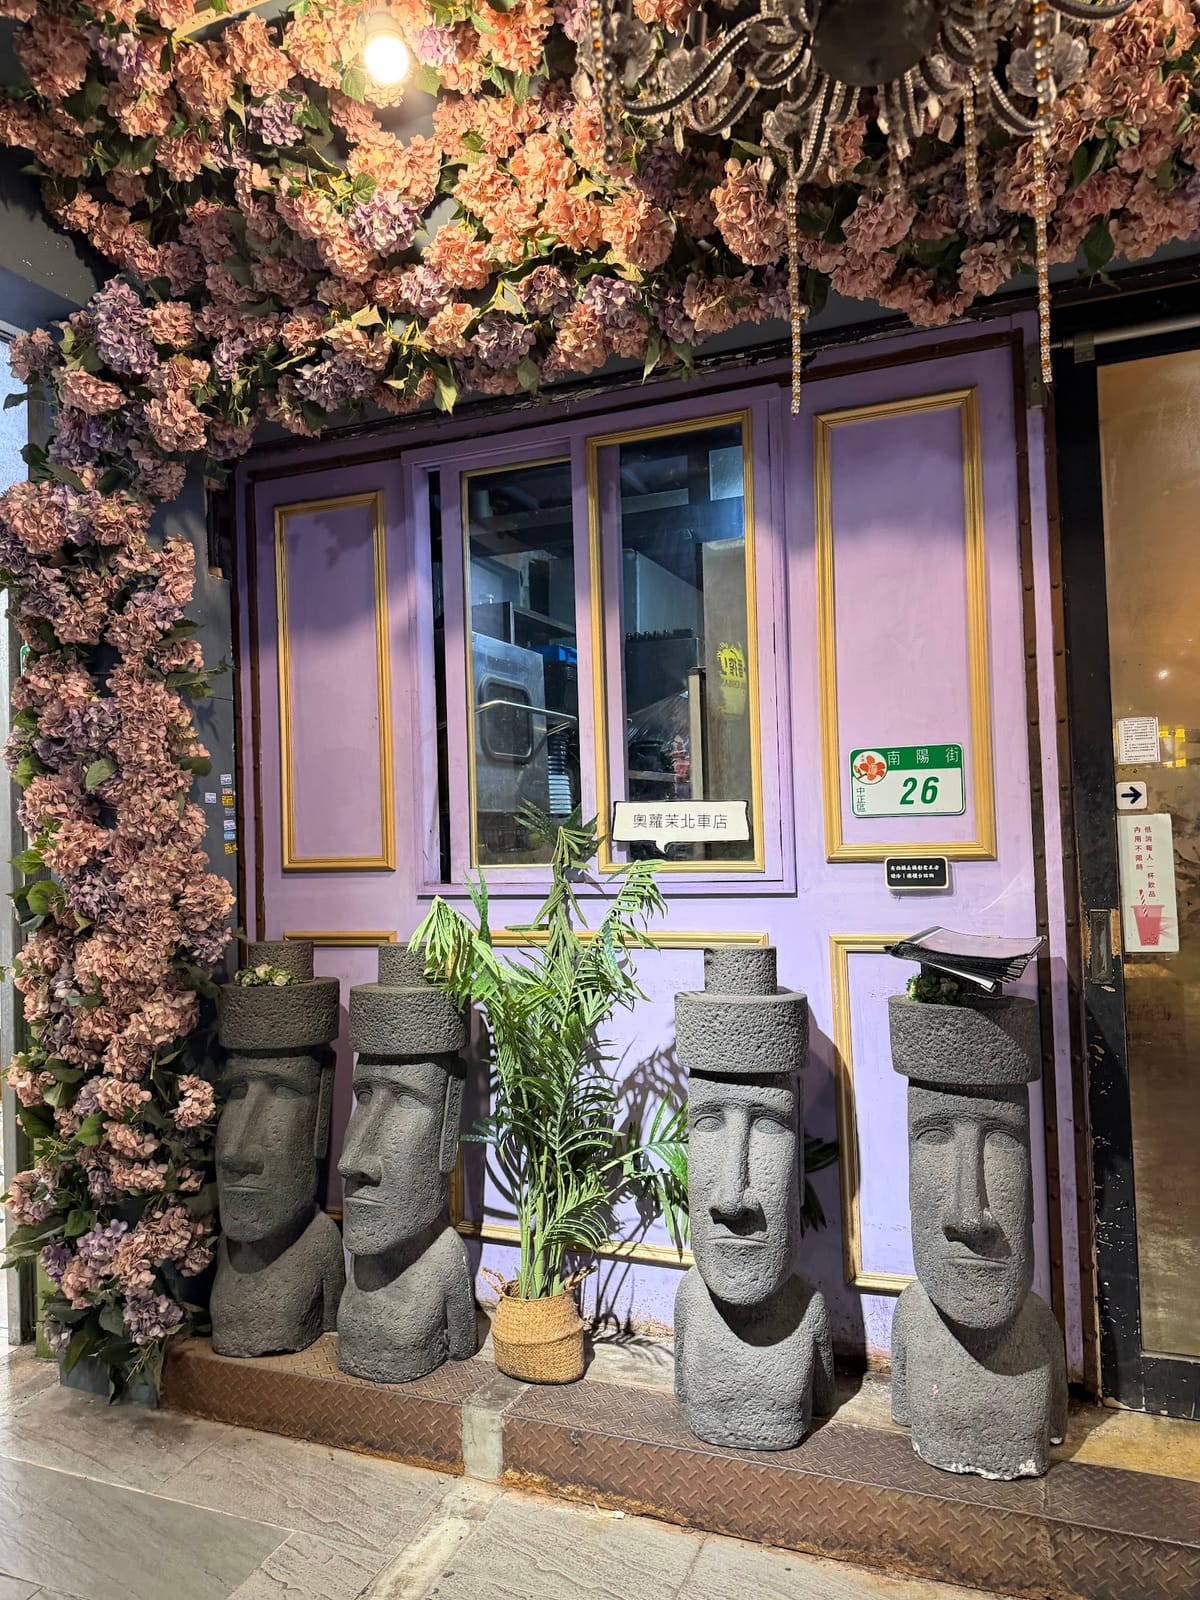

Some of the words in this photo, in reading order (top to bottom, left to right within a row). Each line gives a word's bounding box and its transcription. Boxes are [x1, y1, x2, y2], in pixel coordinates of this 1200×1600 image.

[887, 747, 959, 766] 南陽街
[856, 786, 866, 812] 中正區
[899, 776, 940, 805] 26
[633, 813, 728, 829] 奧蘿茉北車店
